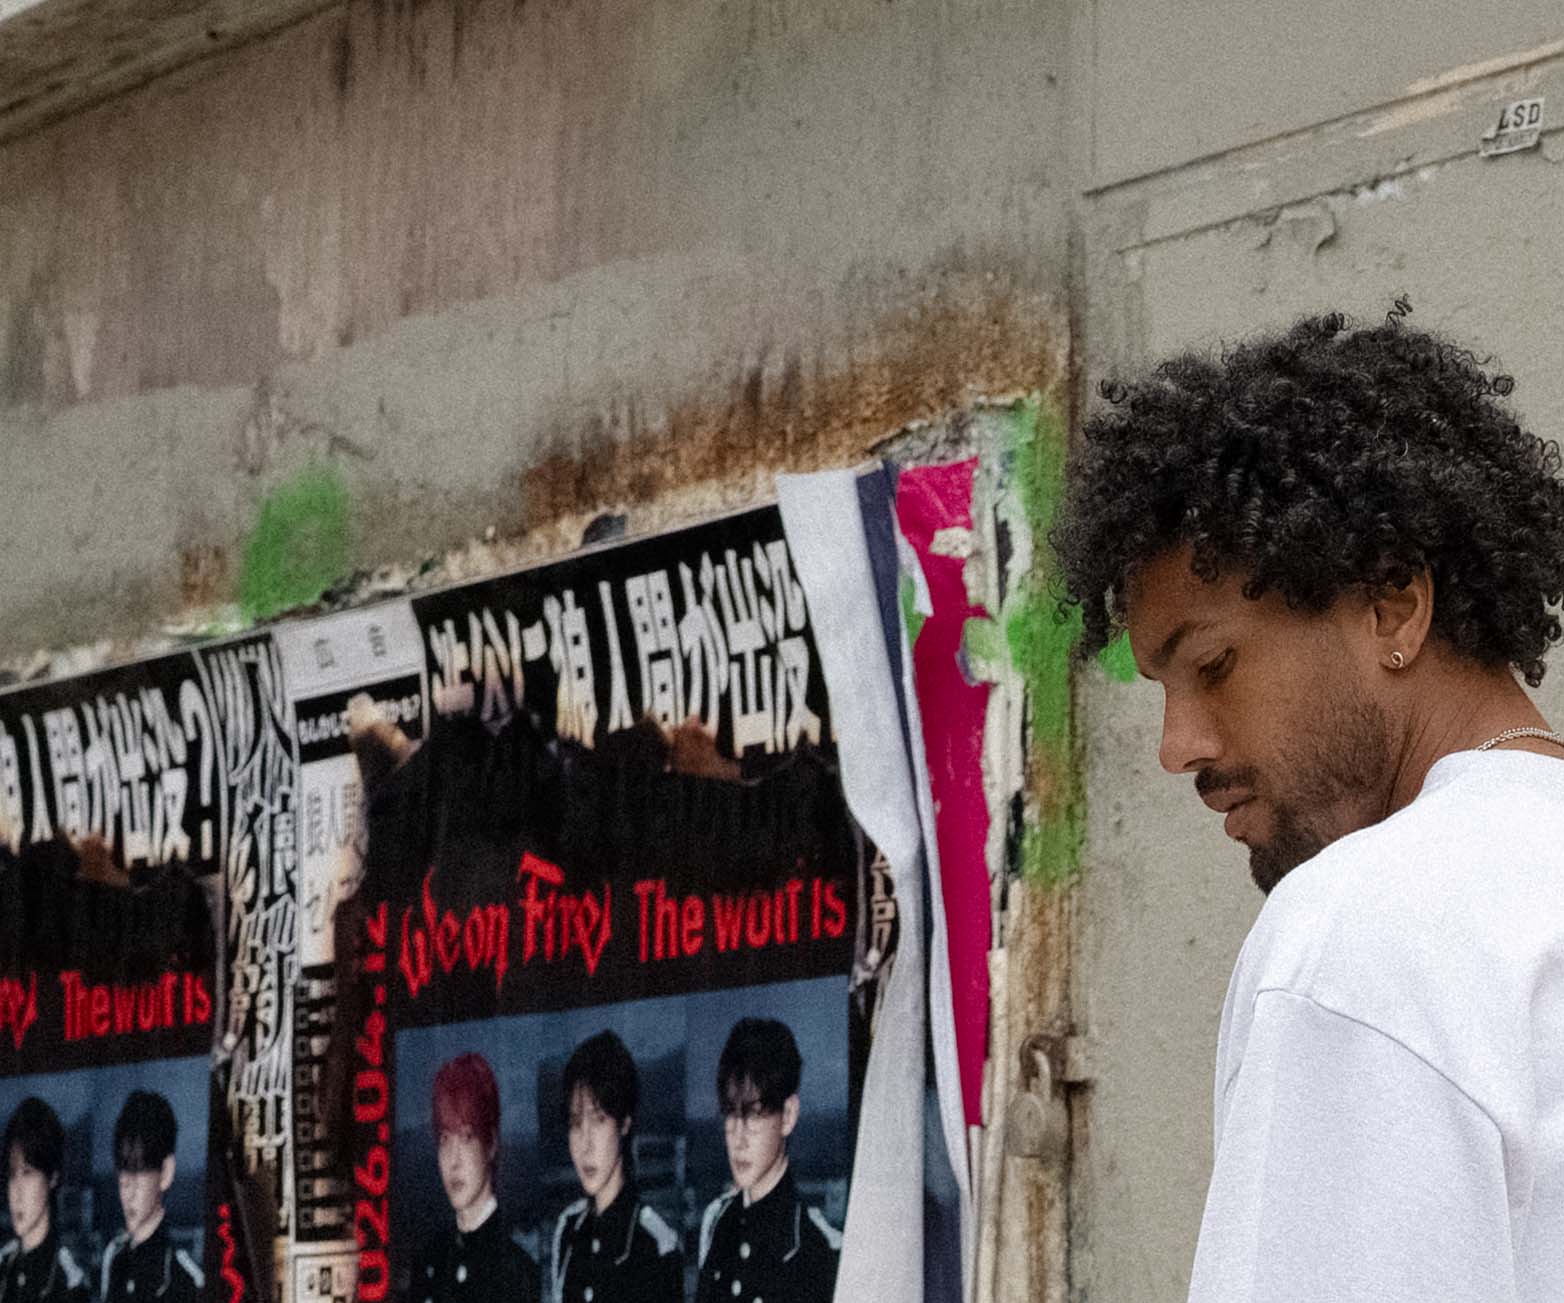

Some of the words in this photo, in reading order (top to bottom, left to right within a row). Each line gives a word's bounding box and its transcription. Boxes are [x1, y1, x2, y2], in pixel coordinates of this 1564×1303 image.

[463, 903, 509, 997] on
[634, 879, 704, 963] The
[60, 969, 111, 1041] The
